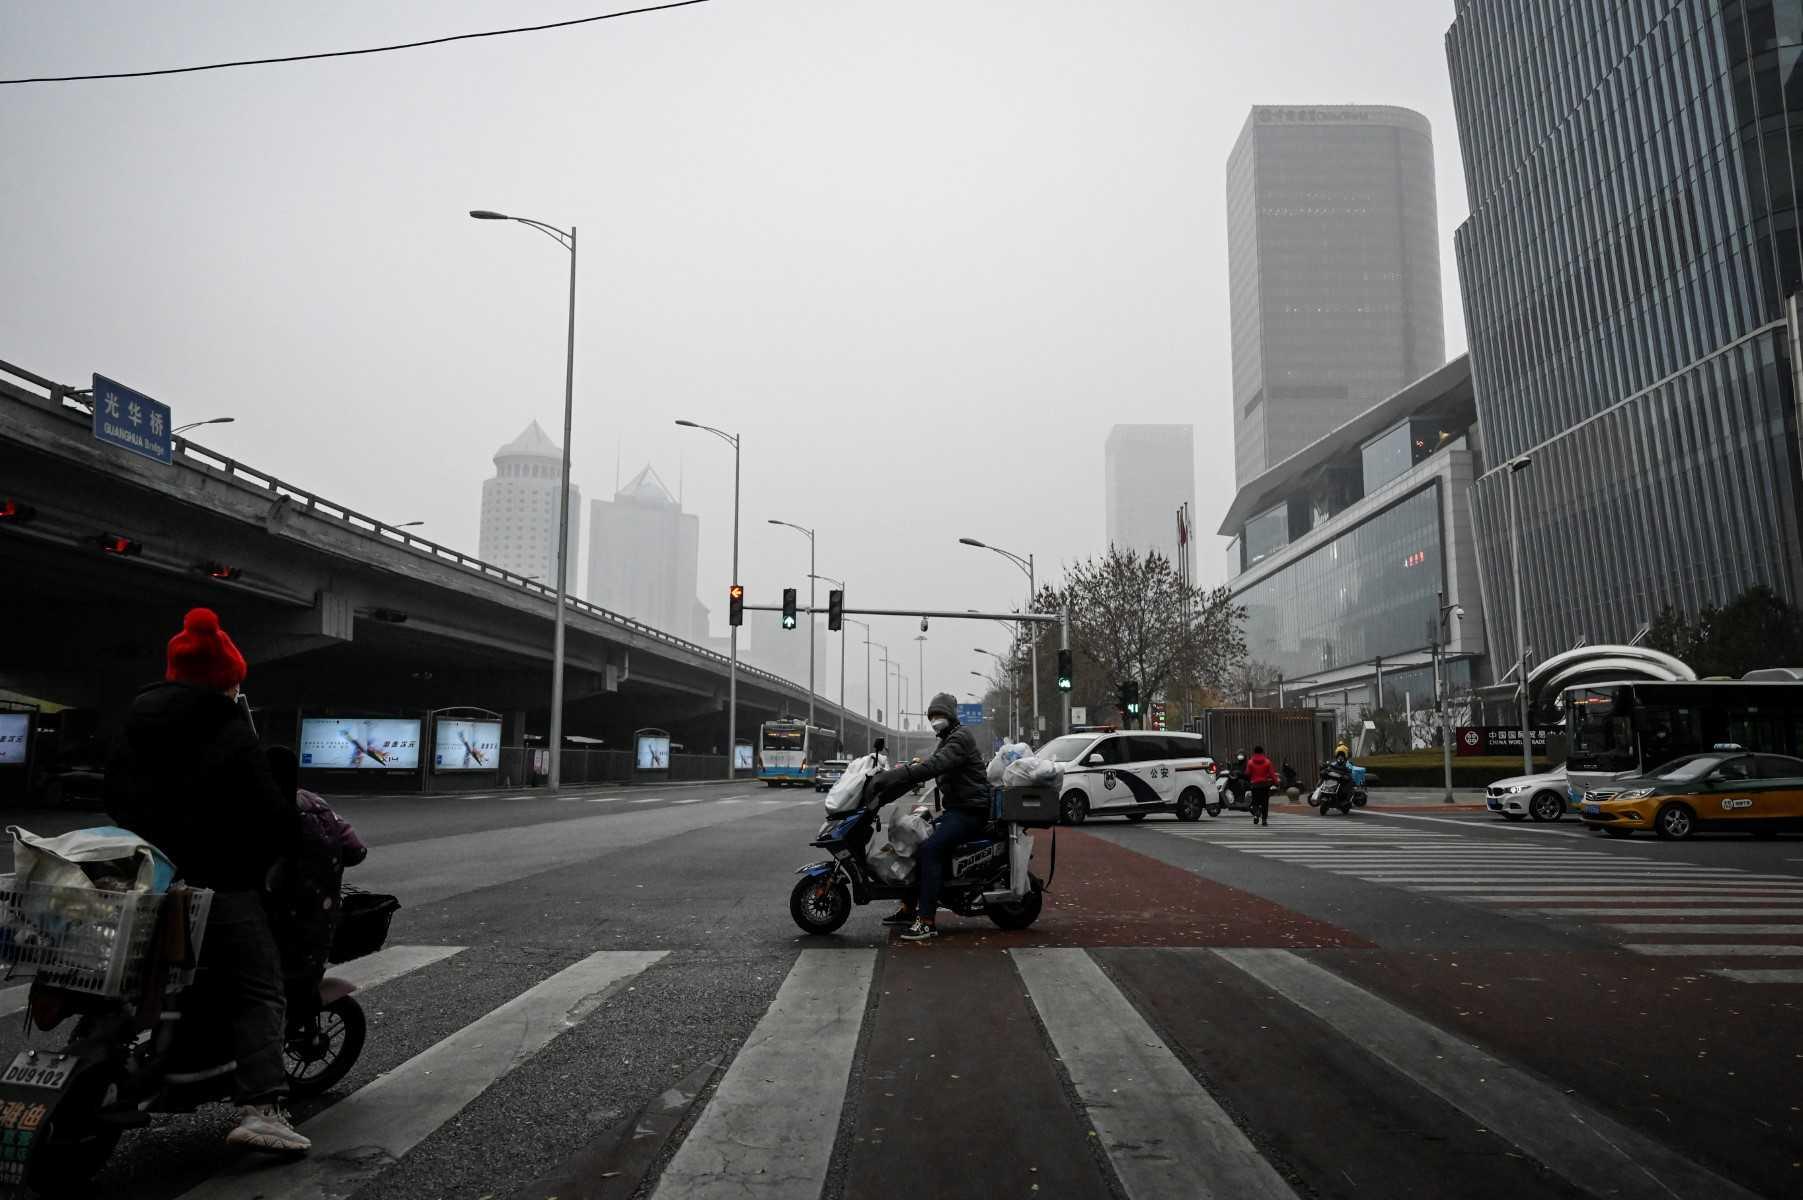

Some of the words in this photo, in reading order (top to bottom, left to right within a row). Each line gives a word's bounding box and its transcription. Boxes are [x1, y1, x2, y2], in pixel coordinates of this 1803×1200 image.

[104, 392, 164, 437] 光华桥
[104, 422, 143, 447] GUANGHUA
[1150, 767, 1169, 779] 公安
[6, 1066, 65, 1086] DU9102
